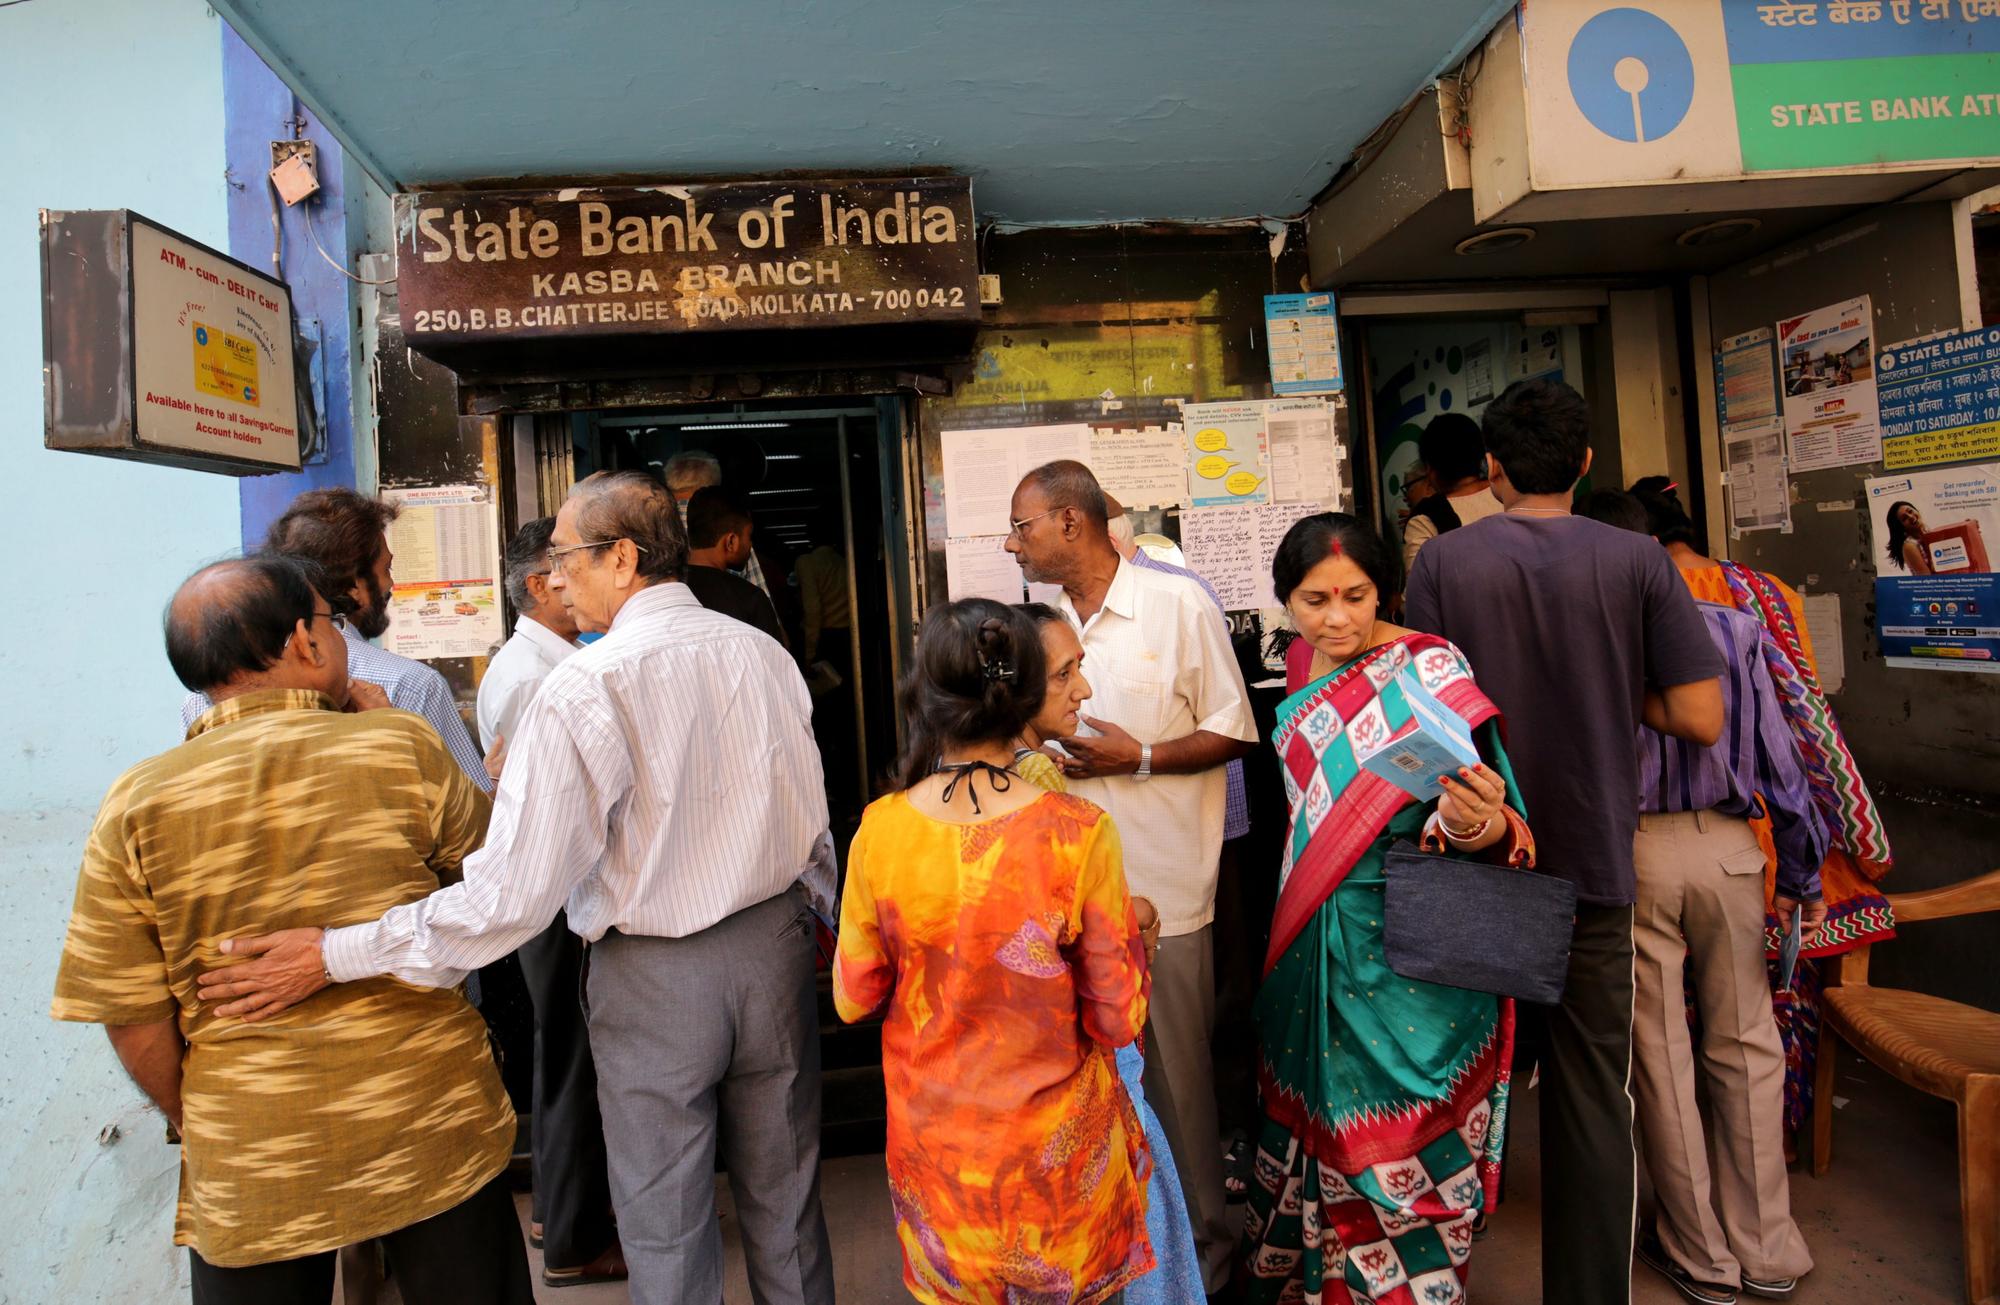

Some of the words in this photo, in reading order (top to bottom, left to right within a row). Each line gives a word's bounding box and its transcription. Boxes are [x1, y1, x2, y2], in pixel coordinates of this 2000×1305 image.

[1770, 101, 1863, 128] STATE
[1870, 95, 1952, 122] BANK
[418, 206, 560, 263] State
[579, 198, 718, 257] Bank
[738, 194, 795, 248] of
[820, 191, 958, 246] India
[160, 248, 186, 270] ATM
[196, 266, 219, 285] cum
[259, 294, 279, 313] Card
[532, 268, 660, 298] KASBA
[682, 260, 841, 291] BRANCH
[1899, 345, 1941, 364] STATE
[1944, 333, 1986, 354] BANK
[145, 391, 192, 412] Available
[194, 403, 214, 417] here
[217, 409, 225, 420] to
[227, 413, 238, 423] all
[1880, 420, 1914, 437] MONDAY
[1915, 418, 1927, 431] TO
[1928, 410, 1974, 430] SATURDAY
[1983, 407, 1995, 420] 10
[196, 421, 232, 438] Account
[233, 429, 262, 444] holders
[1957, 446, 1998, 458] SATURDAY
